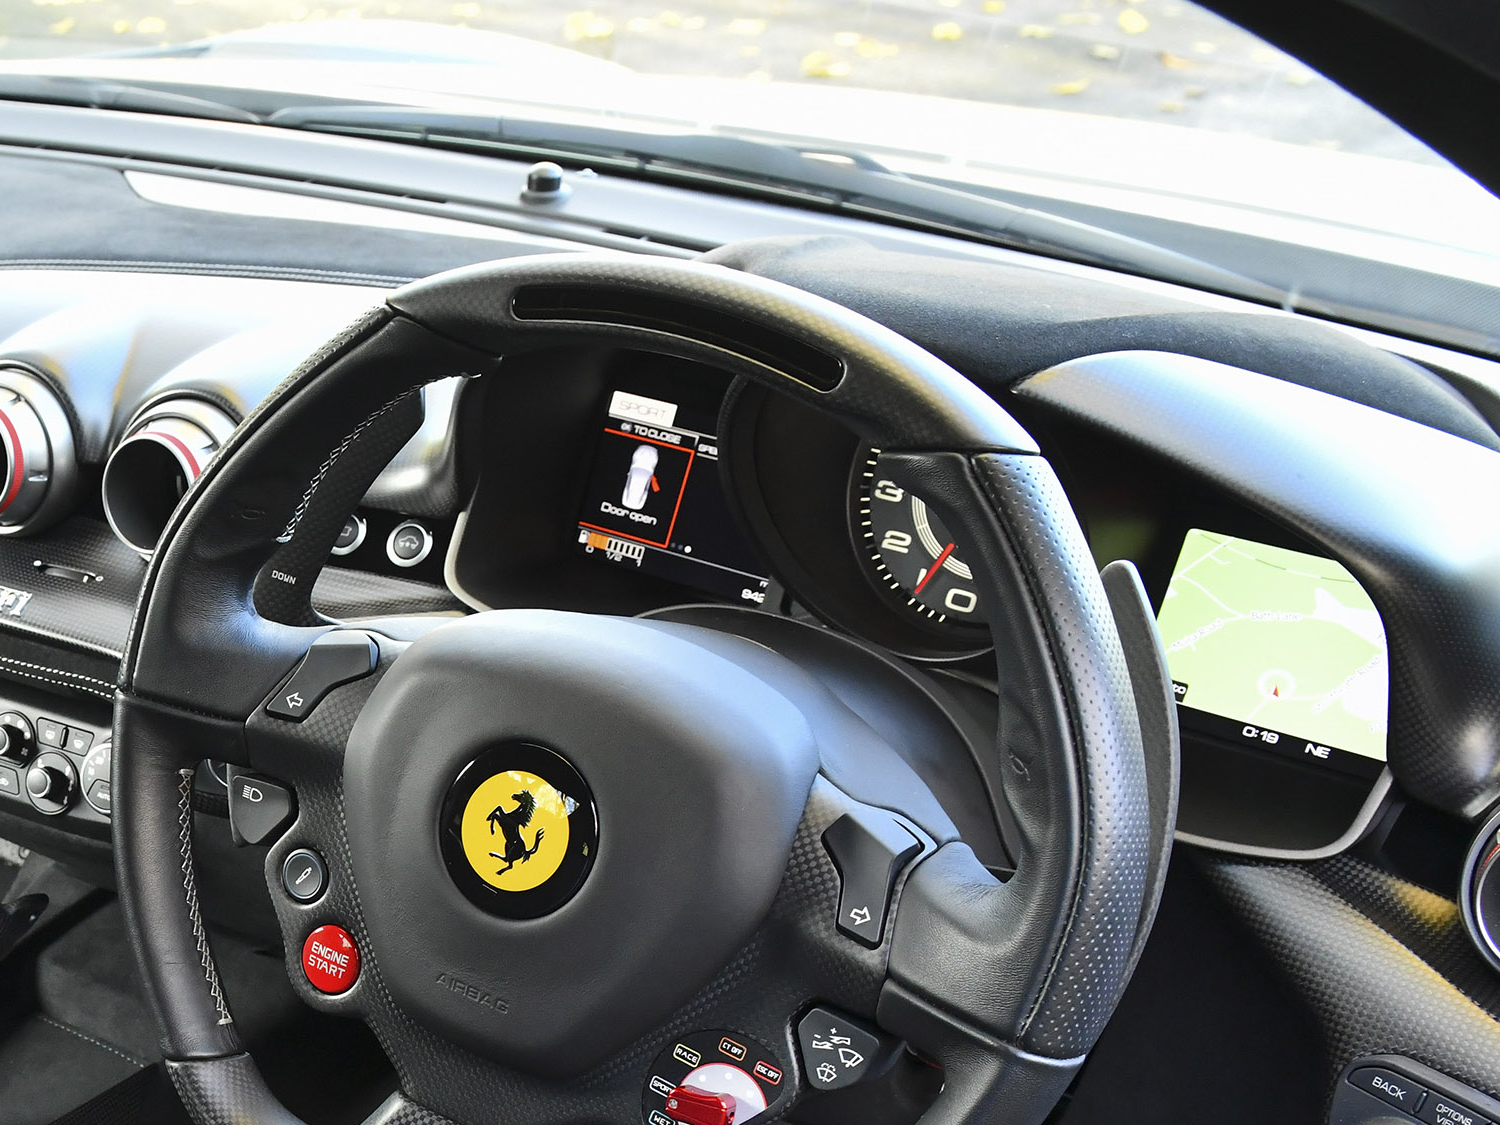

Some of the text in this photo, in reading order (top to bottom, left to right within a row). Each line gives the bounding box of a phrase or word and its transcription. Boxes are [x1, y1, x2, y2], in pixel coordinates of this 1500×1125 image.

[619, 399, 666, 419] SPORT
[634, 424, 648, 436] TO
[648, 428, 682, 445] CLOSE
[874, 479, 904, 503] 3
[600, 501, 657, 526] Door open
[881, 530, 912, 554] 2
[271, 569, 297, 585] DOWN
[944, 587, 978, 613] 0
[1242, 725, 1279, 744] 0:19
[1305, 743, 1331, 759] NE
[311, 941, 349, 968] ENGINE
[308, 954, 346, 979] START
[436, 971, 510, 1014] AIRBAG
[676, 1047, 698, 1064] RACE
[722, 1041, 743, 1056] CT OFF
[756, 1064, 779, 1080] ESC OFF
[1371, 1076, 1407, 1101] BACK
